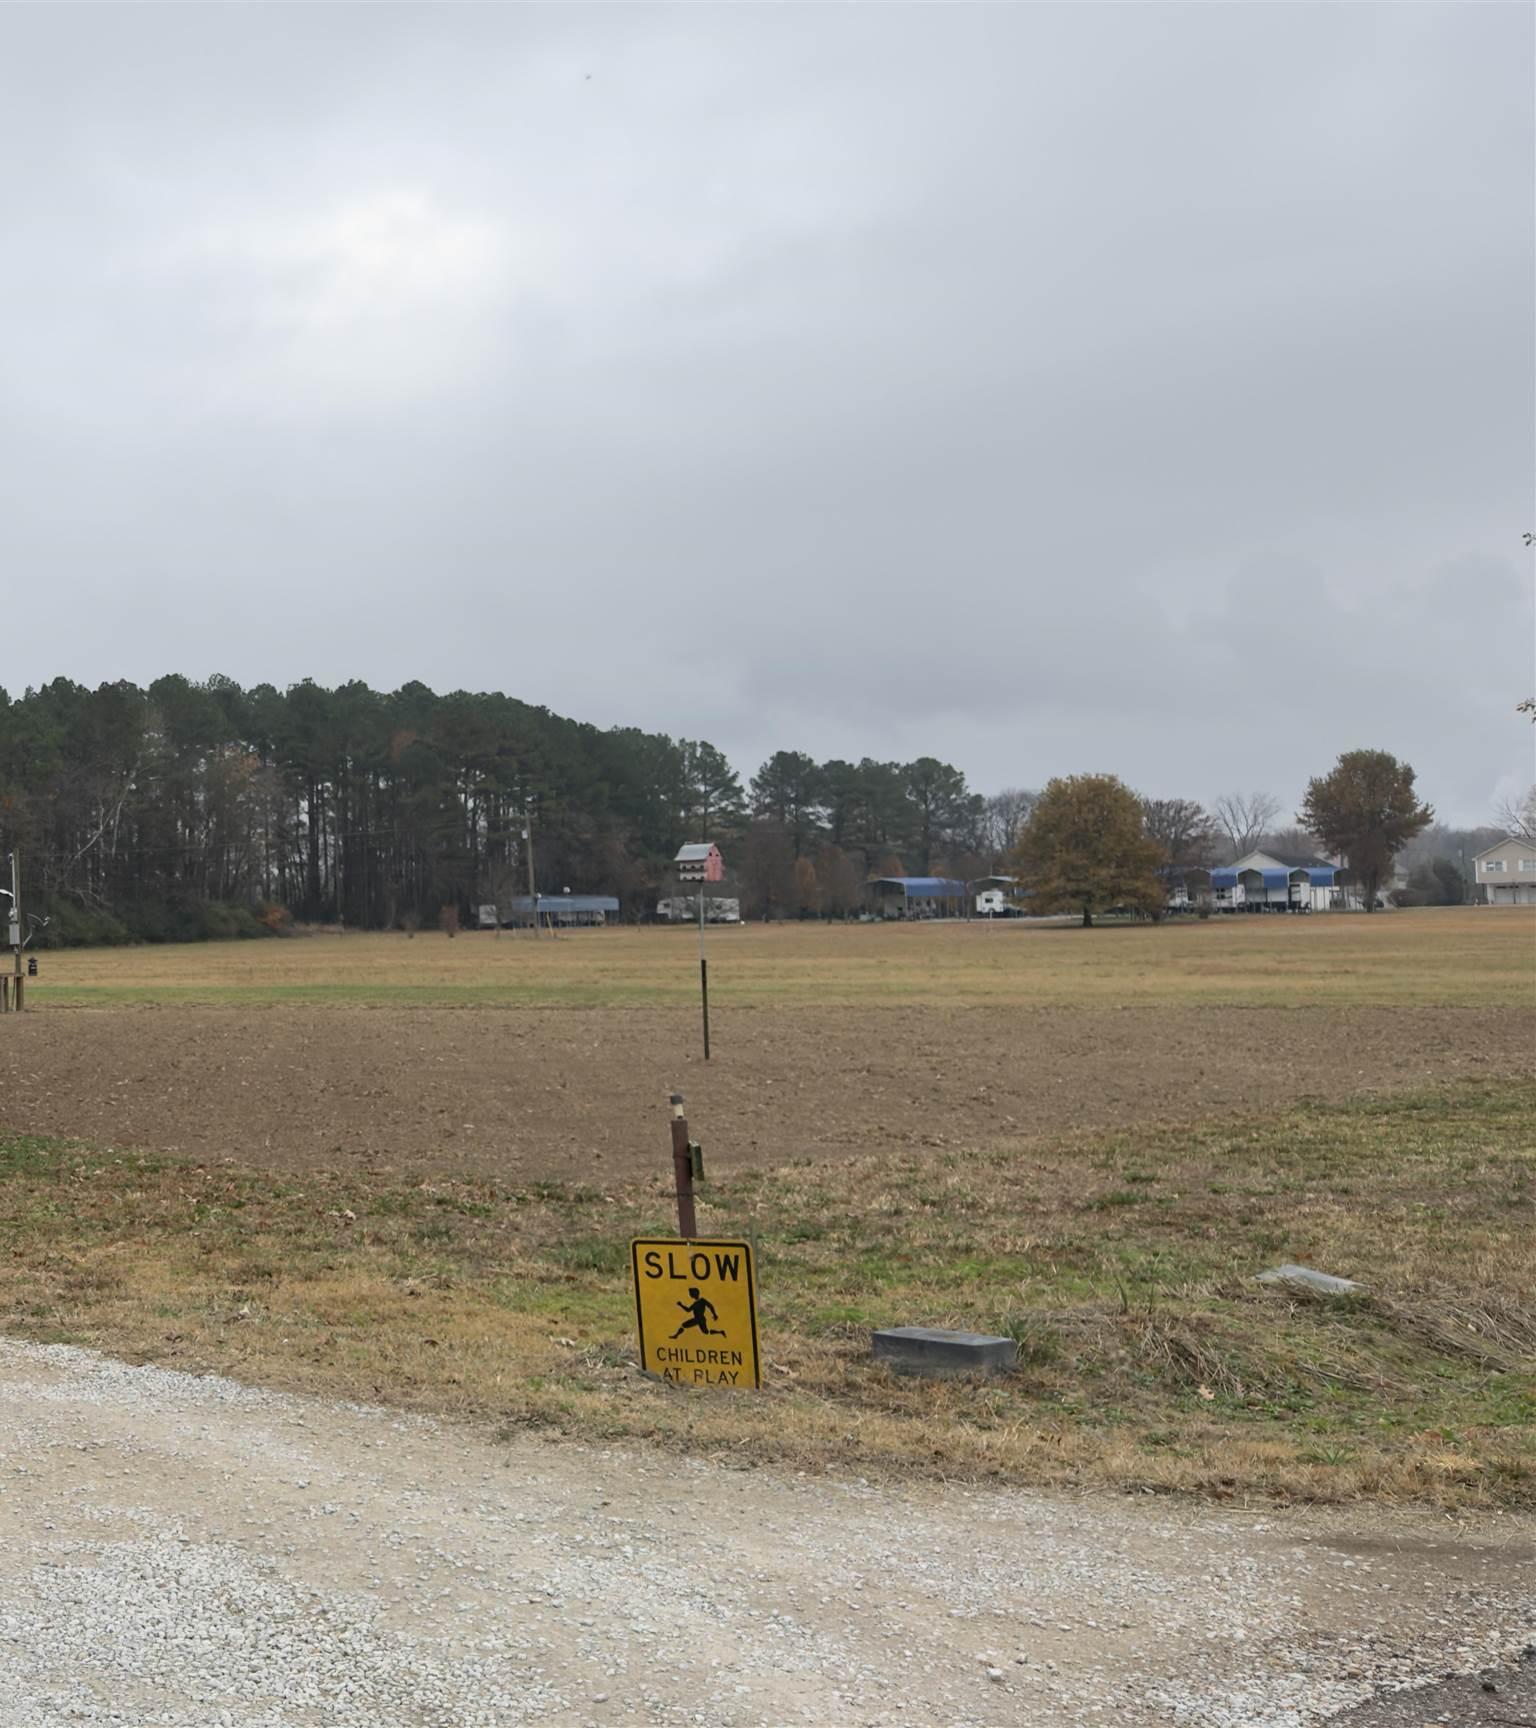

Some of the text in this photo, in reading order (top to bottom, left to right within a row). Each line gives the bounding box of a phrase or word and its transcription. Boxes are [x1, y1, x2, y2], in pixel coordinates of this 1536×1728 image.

[645, 1252, 739, 1281] SLOW
[656, 1347, 743, 1365] CHILDREN
[663, 1367, 739, 1385] AT PLAY
